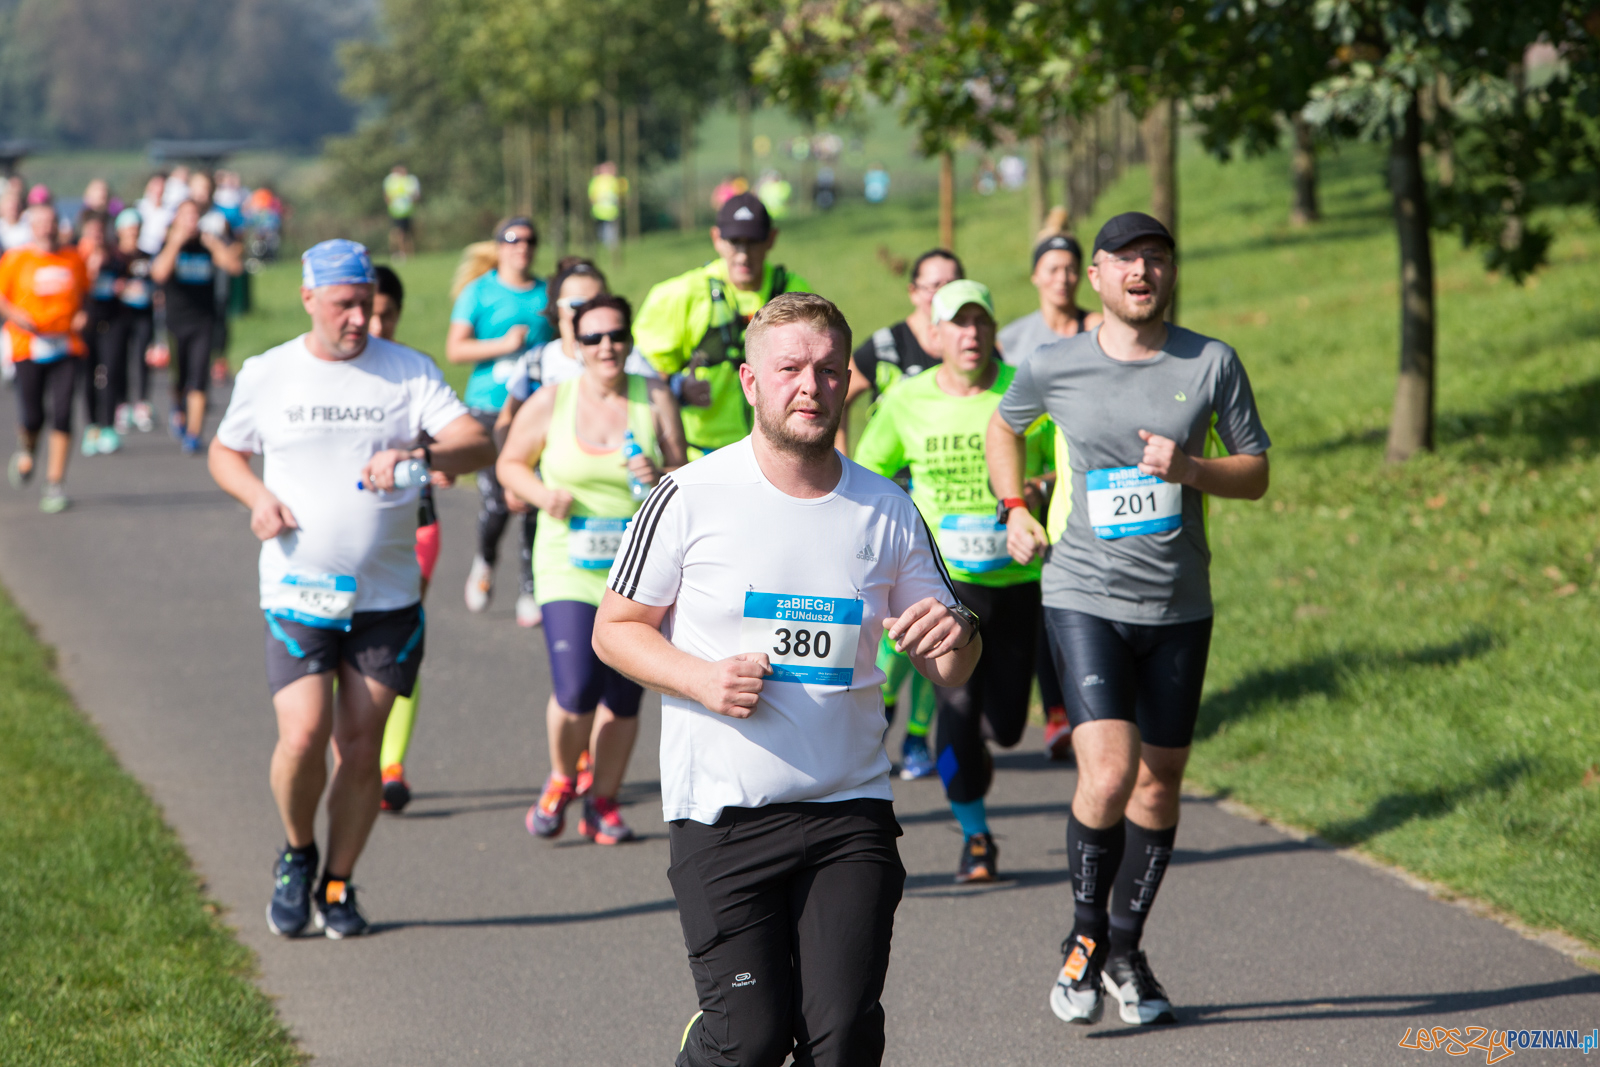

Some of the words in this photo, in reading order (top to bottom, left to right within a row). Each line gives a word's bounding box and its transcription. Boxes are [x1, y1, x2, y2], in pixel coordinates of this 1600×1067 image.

[311, 405, 385, 422] FIBARO
[1113, 491, 1157, 516] 201
[959, 536, 997, 556] 353
[775, 611, 783, 619] o
[785, 610, 834, 622] FUNdusze
[776, 597, 835, 615] zaBIEGaj
[772, 627, 832, 659] 380
[1075, 840, 1108, 904] Kalenji
[1129, 844, 1173, 913] Kalenji
